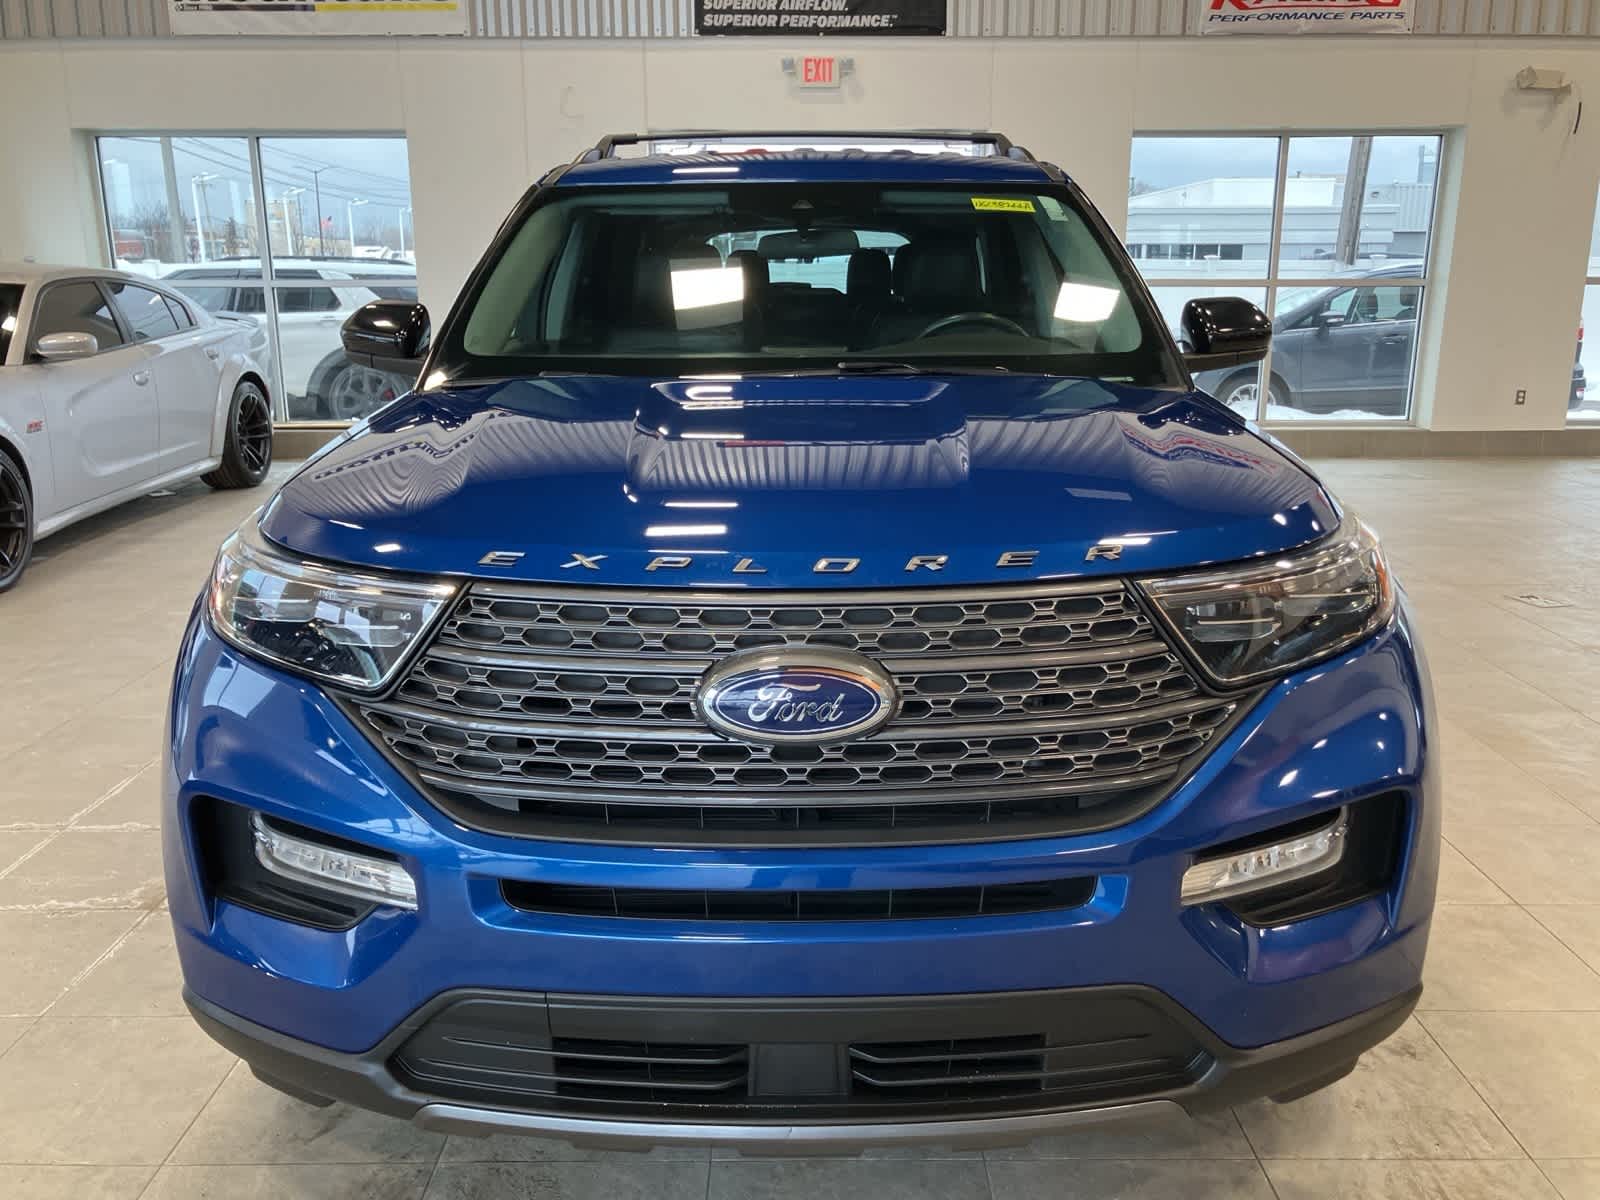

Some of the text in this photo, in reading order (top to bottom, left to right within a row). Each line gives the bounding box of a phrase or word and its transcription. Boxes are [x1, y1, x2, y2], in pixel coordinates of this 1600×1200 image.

[703, 0, 849, 12] SUPERIOR AIRFLOW.
[703, 14, 776, 27] SUPERIOR
[1208, 11, 1406, 23] PERFORMANCE PARTS
[804, 57, 834, 83] EXIT
[477, 544, 1124, 573] EXPLORER
[746, 683, 844, 723] Ford
